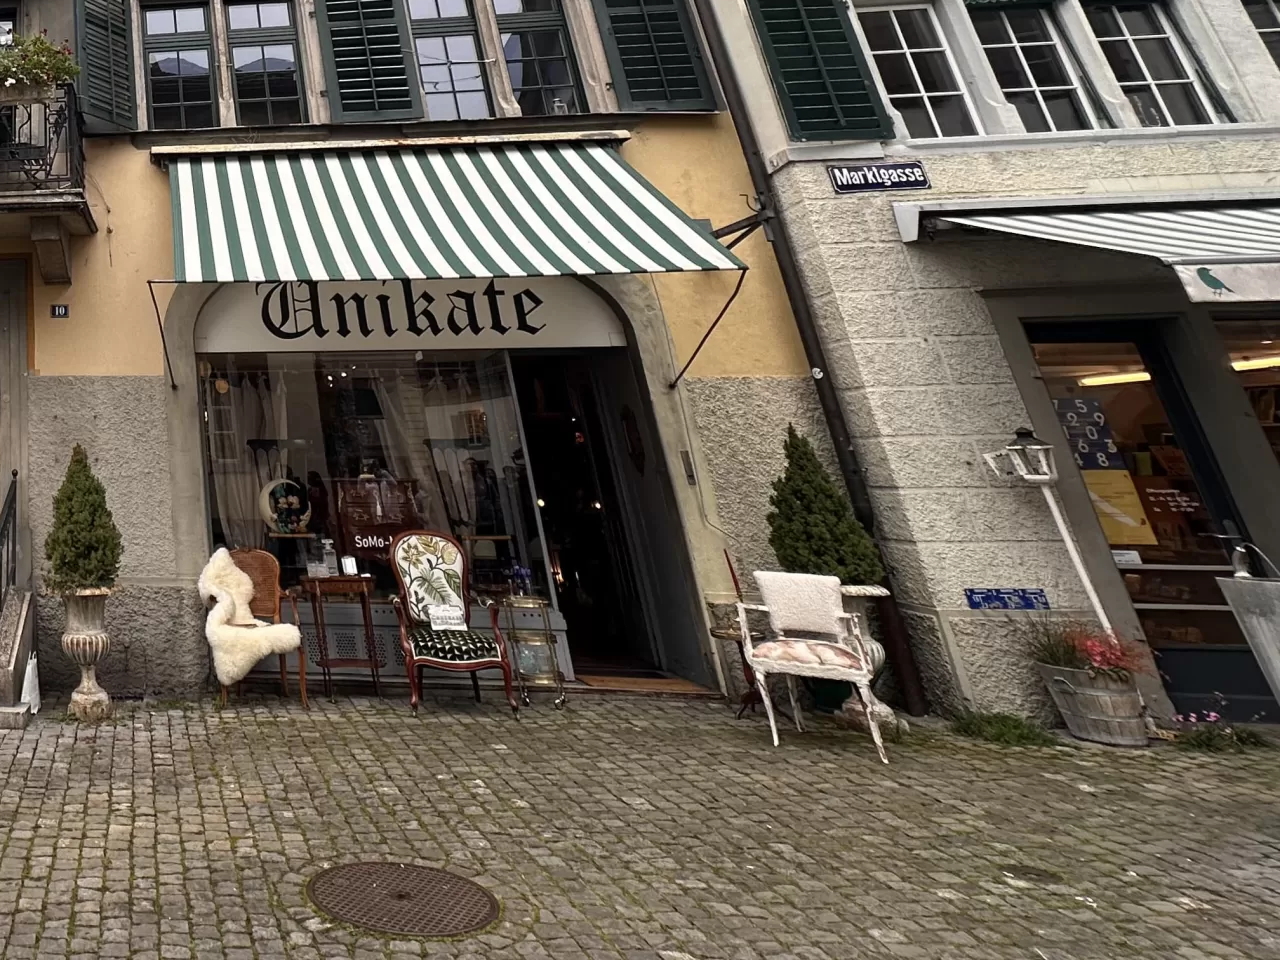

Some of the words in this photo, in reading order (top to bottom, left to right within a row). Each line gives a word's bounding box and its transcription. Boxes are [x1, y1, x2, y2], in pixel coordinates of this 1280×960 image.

[833, 166, 925, 187] Marktgasse
[55, 306, 65, 316] 10
[254, 277, 547, 340] Unikate
[1074, 399, 1088, 413] 5
[1066, 412, 1080, 426] 2
[1093, 412, 1105, 427] 9
[1078, 439, 1089, 453] 6
[1103, 438, 1118, 453] 3
[1096, 452, 1109, 467] 8
[354, 535, 395, 548] SoMo-
